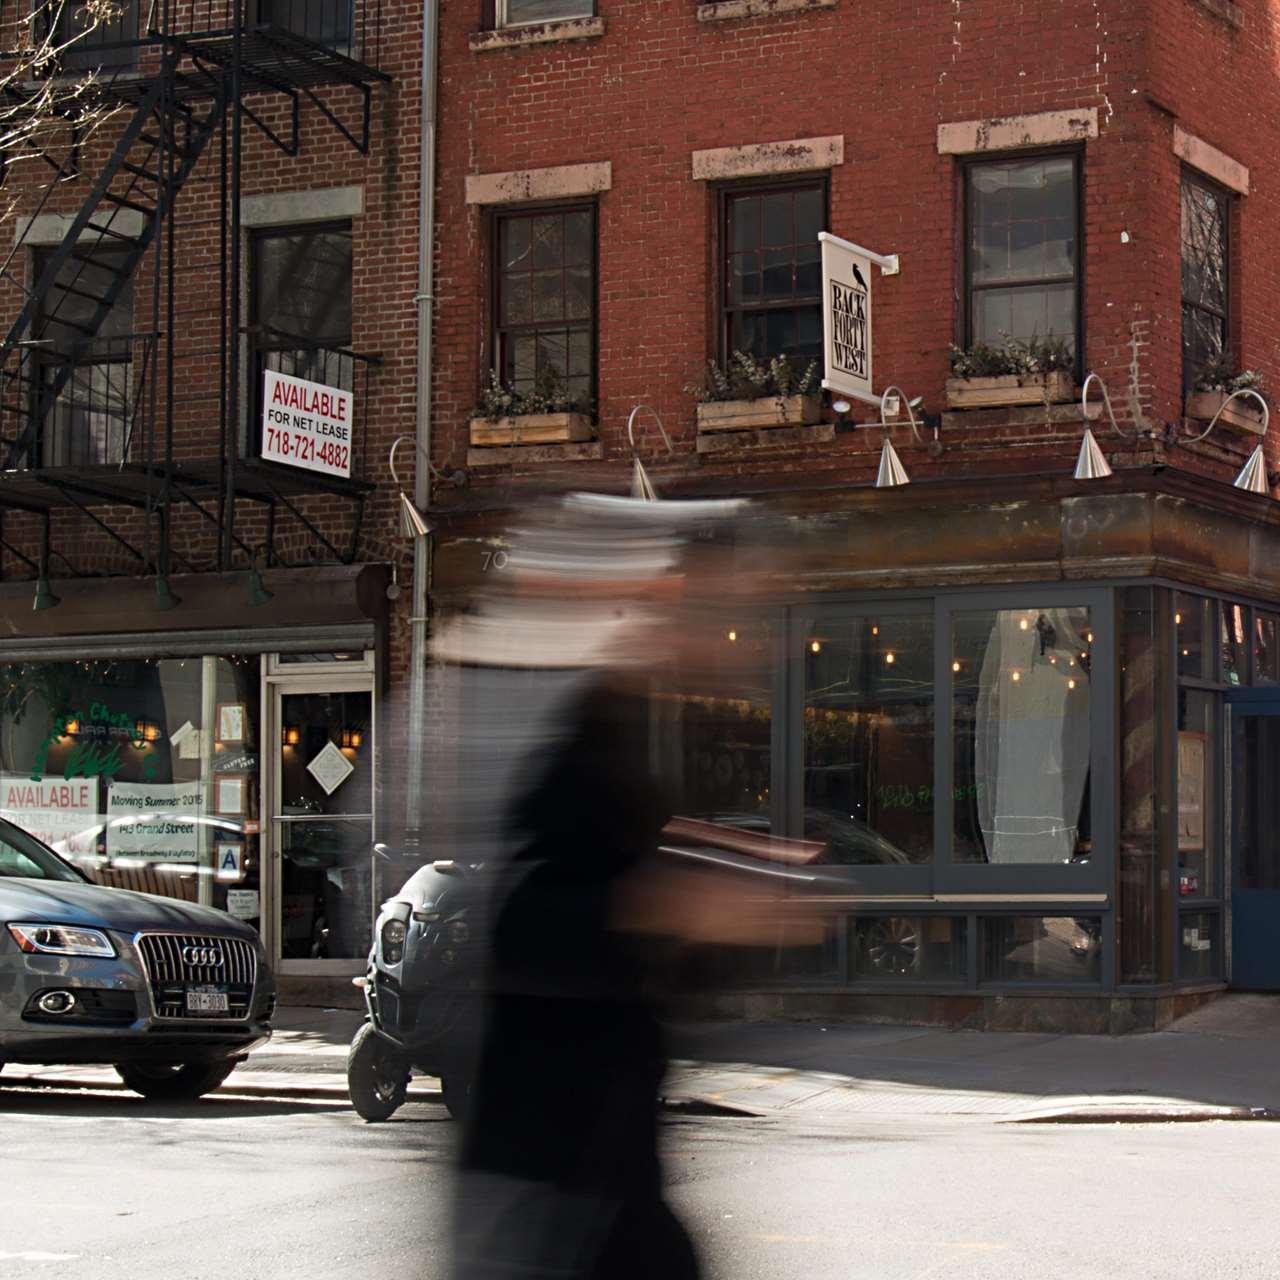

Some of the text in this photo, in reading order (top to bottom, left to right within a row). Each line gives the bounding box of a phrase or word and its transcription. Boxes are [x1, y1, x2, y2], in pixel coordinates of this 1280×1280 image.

[833, 284, 865, 320] BACK
[833, 310, 865, 351] FORTY
[834, 342, 865, 375] WEST
[272, 380, 346, 421] AVAILABLE
[268, 409, 348, 440] FOR NET LEASE
[267, 428, 349, 469] 718-721-4882
[7, 786, 89, 808] AVAILABLE
[111, 795, 143, 808] Moving
[144, 795, 180, 807] Summer
[135, 822, 165, 835] Grand
[166, 823, 195, 835] Street
[222, 849, 237, 870] A
